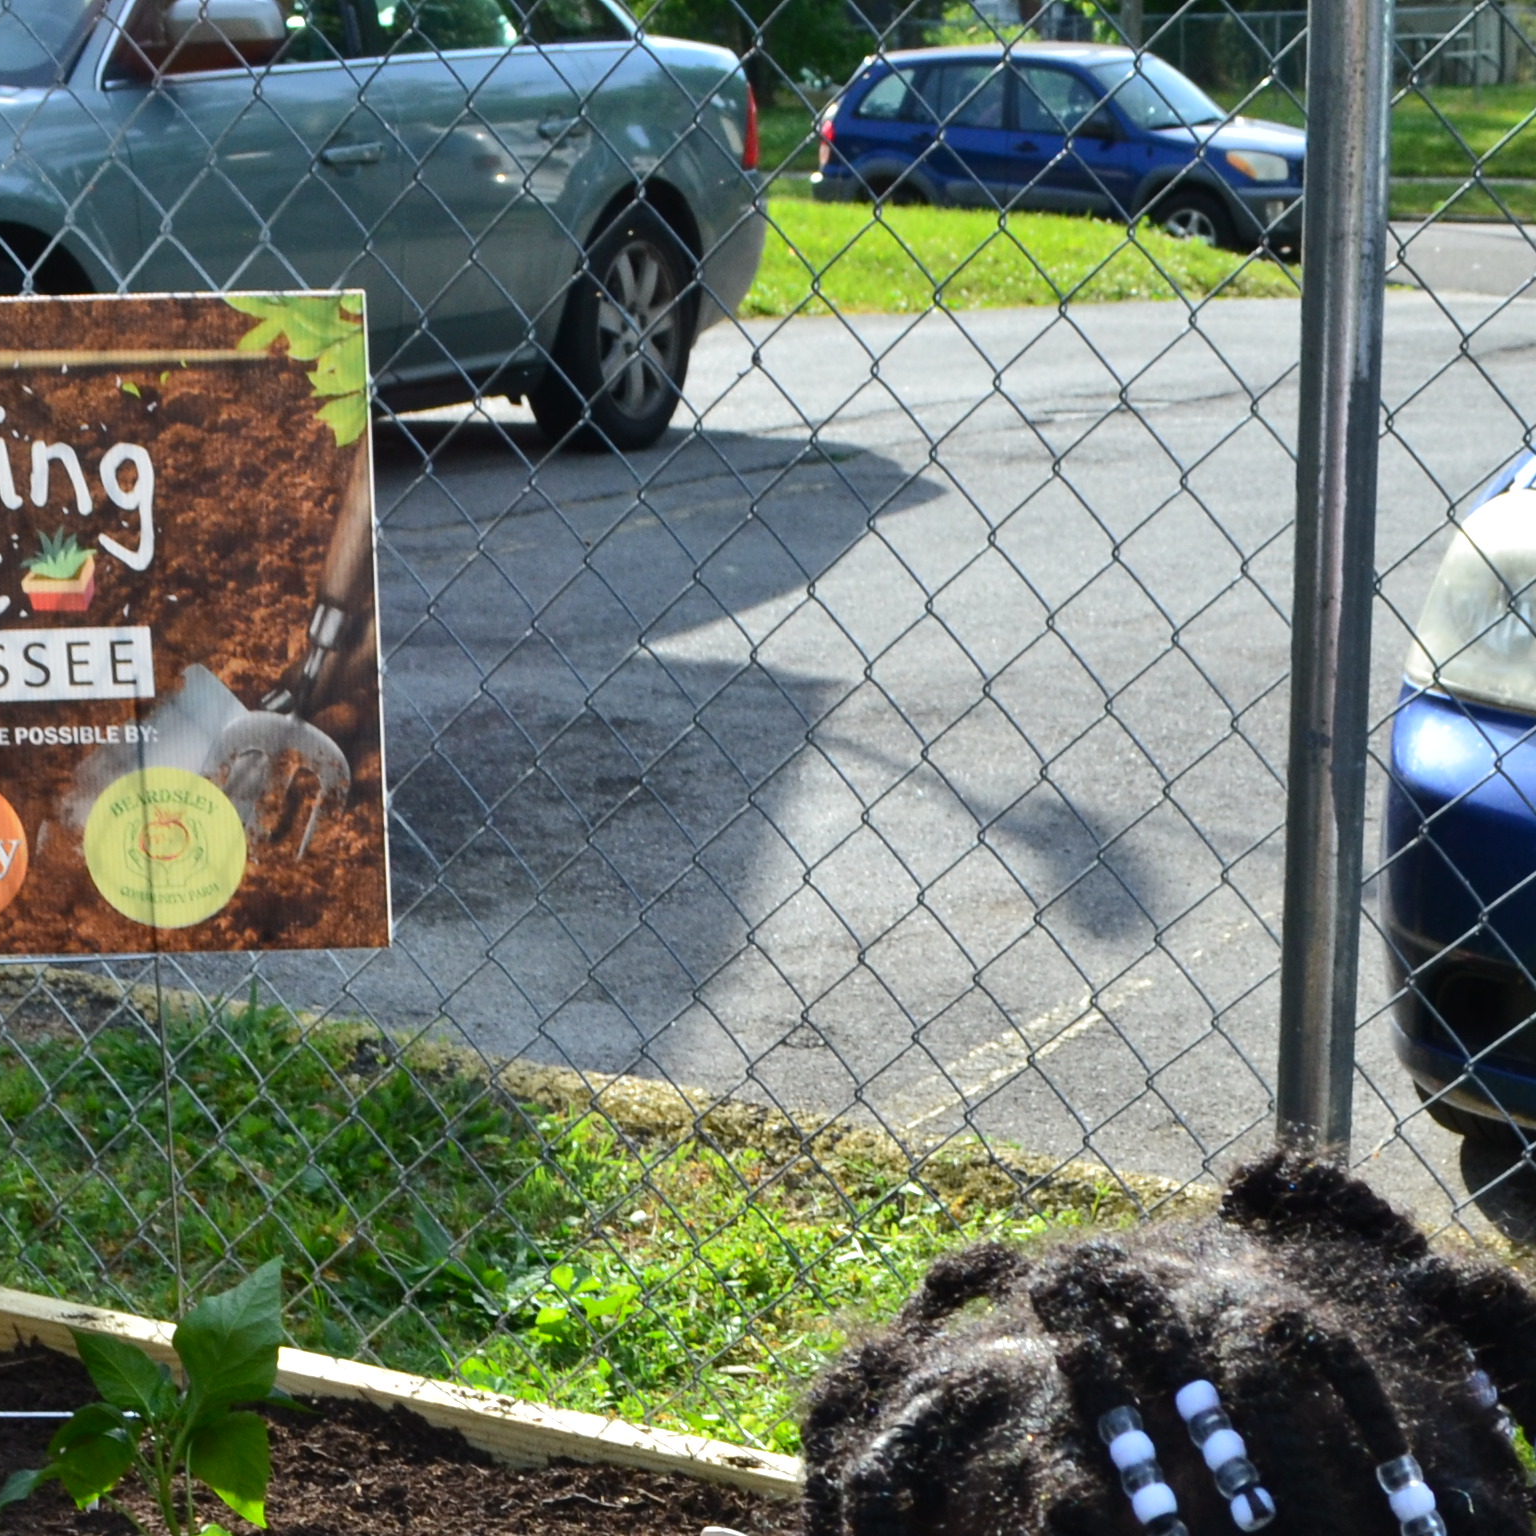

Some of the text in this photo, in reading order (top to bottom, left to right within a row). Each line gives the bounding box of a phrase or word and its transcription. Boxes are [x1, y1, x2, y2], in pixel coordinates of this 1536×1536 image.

[15, 726, 120, 746] POSSIBLE
[124, 725, 159, 744] BY:
[109, 788, 219, 818] BEARDSLEY
[189, 882, 221, 903] FARM
